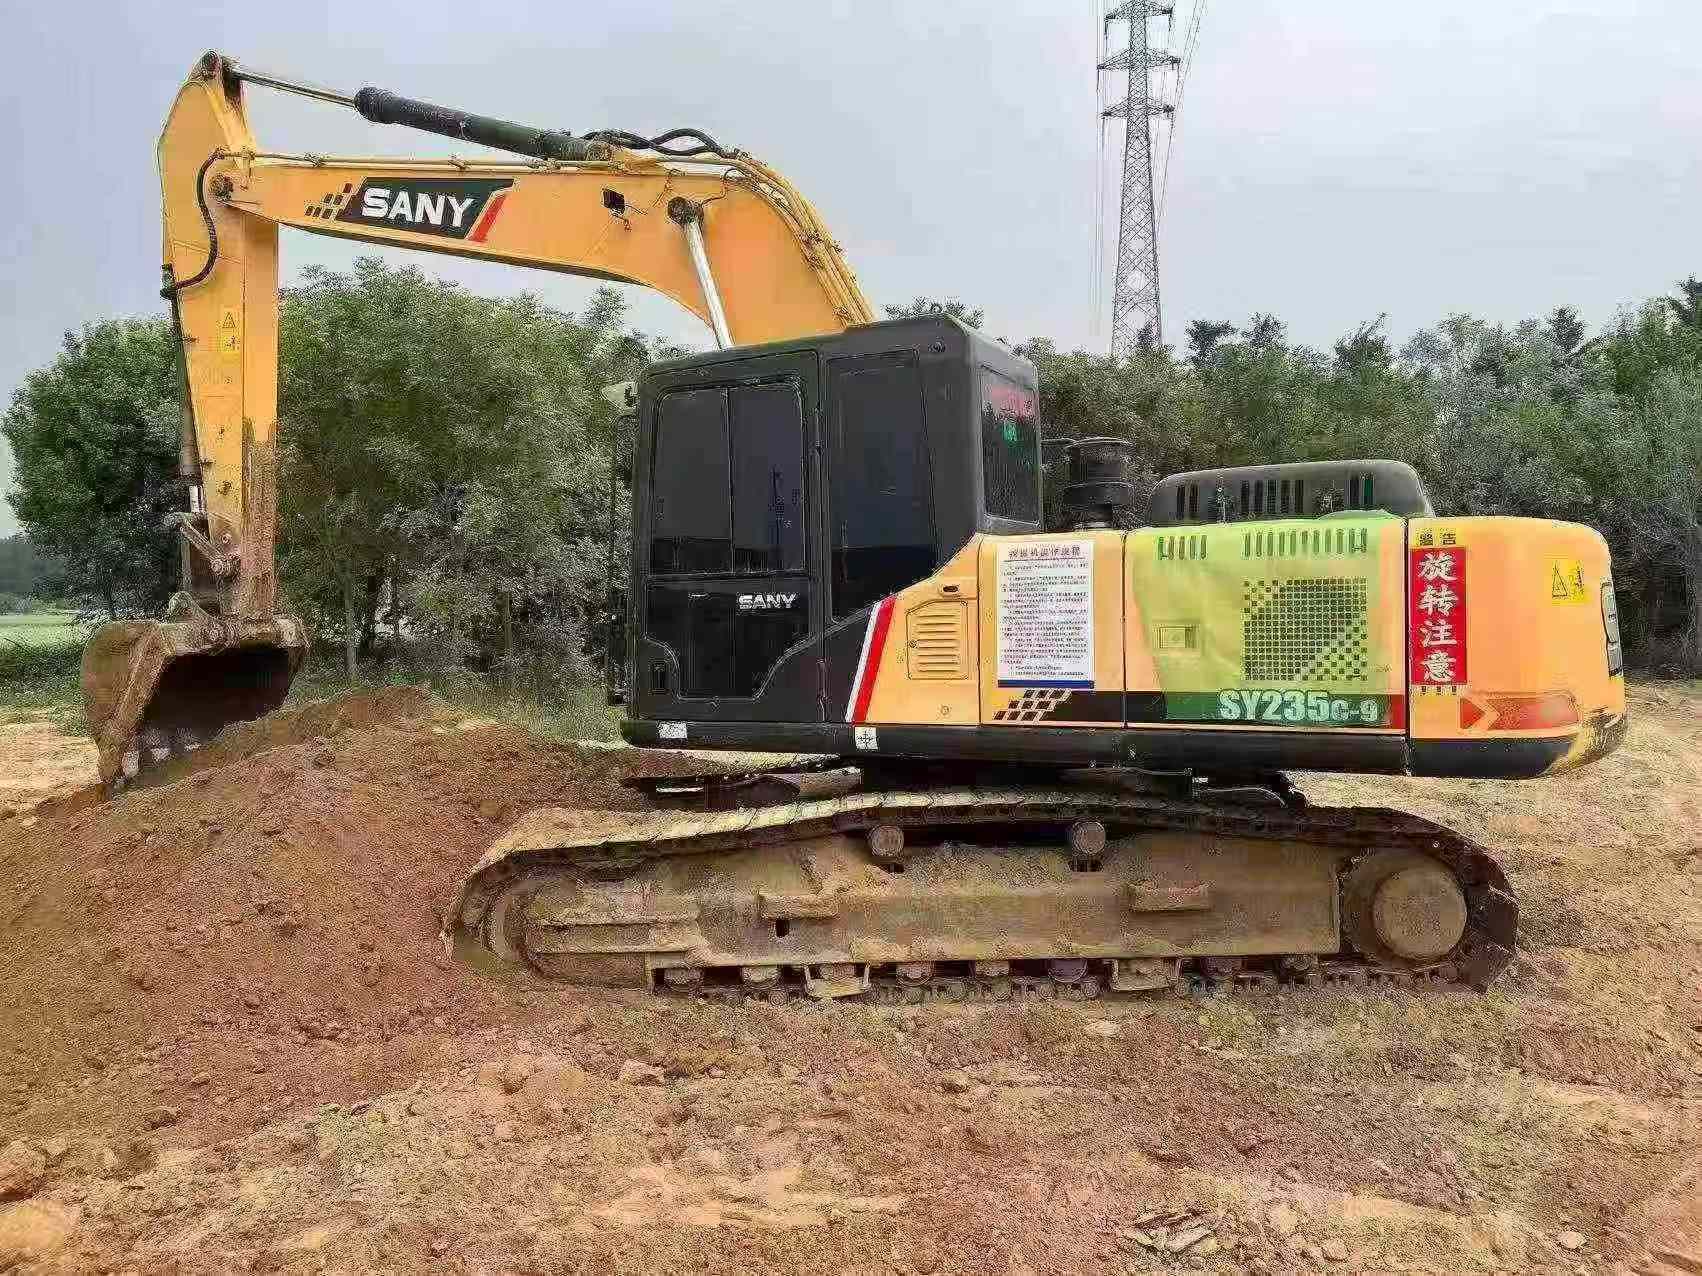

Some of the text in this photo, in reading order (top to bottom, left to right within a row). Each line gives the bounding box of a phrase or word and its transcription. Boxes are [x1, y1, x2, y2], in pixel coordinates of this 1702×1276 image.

[361, 187, 475, 227] SANY
[738, 594, 797, 609] SANY
[1418, 552, 1458, 682] 旋转注意
